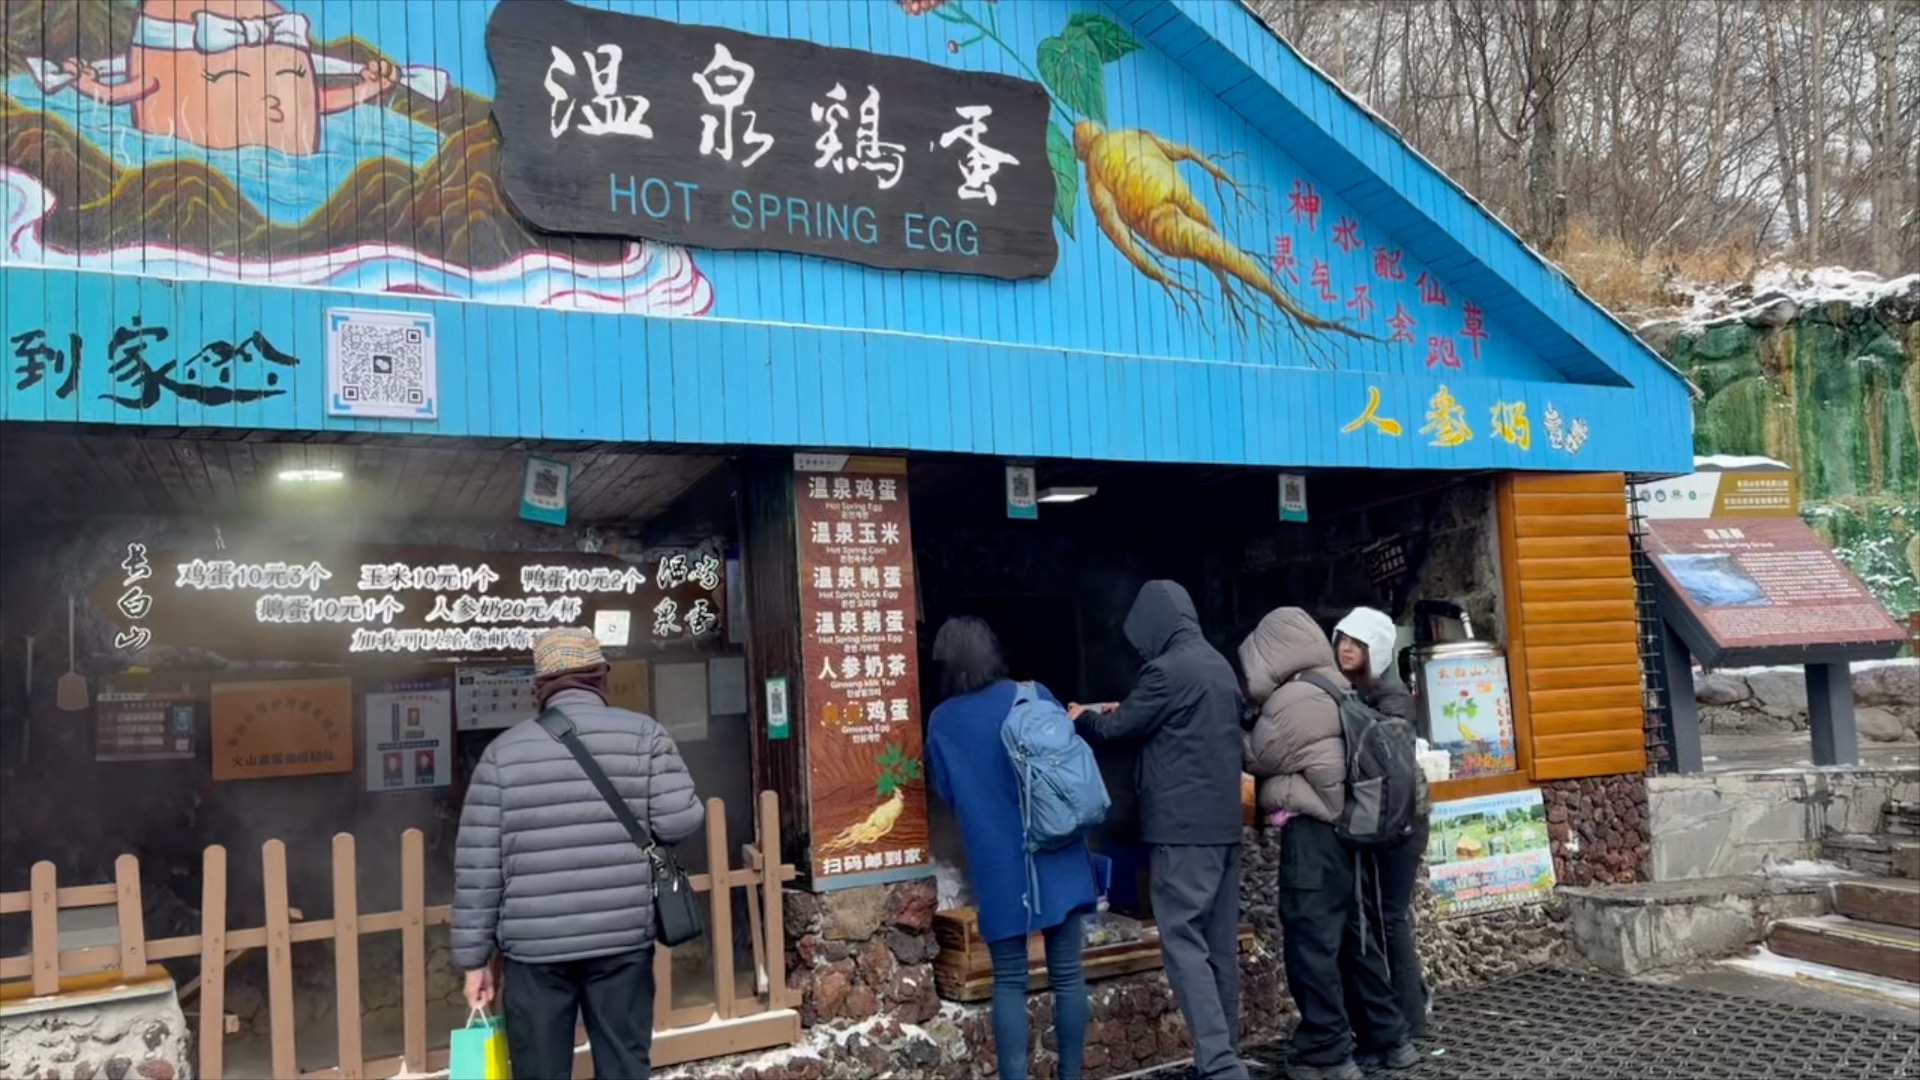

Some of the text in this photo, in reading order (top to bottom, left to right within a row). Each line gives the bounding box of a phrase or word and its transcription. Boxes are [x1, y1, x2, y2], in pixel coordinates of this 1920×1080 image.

[609, 173, 980, 256] HOT SPRING EGG
[1288, 179, 1488, 359] 神水配仙草
[11, 316, 230, 409] 到家
[808, 476, 898, 500] 温泉鸡蛋
[825, 502, 883, 512] Hot Spring Egg
[810, 521, 899, 544] 温泉玉米
[842, 547, 867, 555] Spring
[176, 558, 332, 591] 鸡蛋10元3个
[358, 563, 499, 593] 玉米10元1个
[521, 564, 646, 594] 鸭蛋10元2个
[813, 566, 902, 589] 温泉鸭蛋
[425, 594, 583, 623] 人参奶20元/杯
[836, 591, 860, 600] Spring
[883, 591, 898, 599] Egg
[256, 594, 404, 624] 鹅蛋10元1个
[815, 610, 904, 634] 温泉鹅蛋
[350, 627, 560, 652] 加我可以给您邮寄
[819, 636, 834, 644] Hot
[835, 635, 860, 644] Spring
[888, 634, 903, 643] Egg
[818, 653, 906, 680] 人参奶茶
[831, 680, 863, 689] Ginseng
[882, 679, 896, 687] Tea
[820, 698, 909, 726] 鸡蛋
[841, 724, 890, 734] Ginseng Egg
[822, 847, 922, 875] 扫码邮到家
